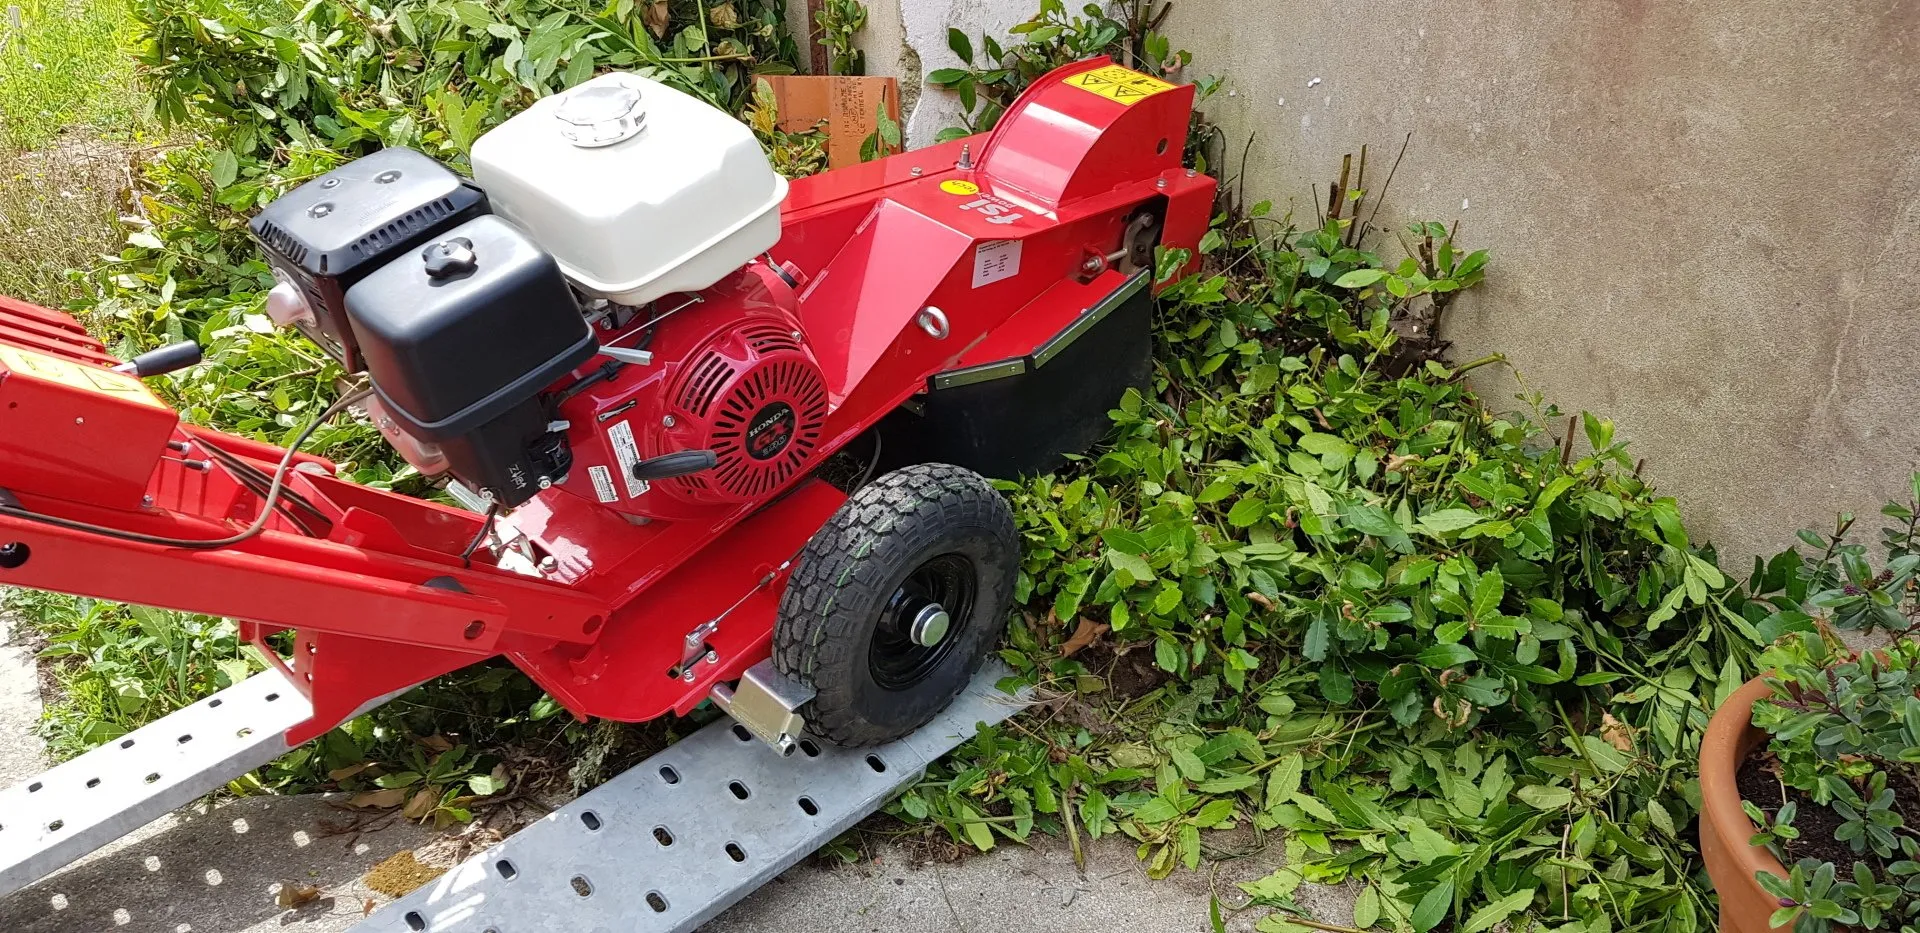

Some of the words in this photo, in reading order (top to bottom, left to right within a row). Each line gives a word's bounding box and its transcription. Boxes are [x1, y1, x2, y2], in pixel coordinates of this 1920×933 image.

[959, 199, 1023, 224] fsi
[976, 192, 1017, 208] power
[749, 408, 789, 437] HONDA
